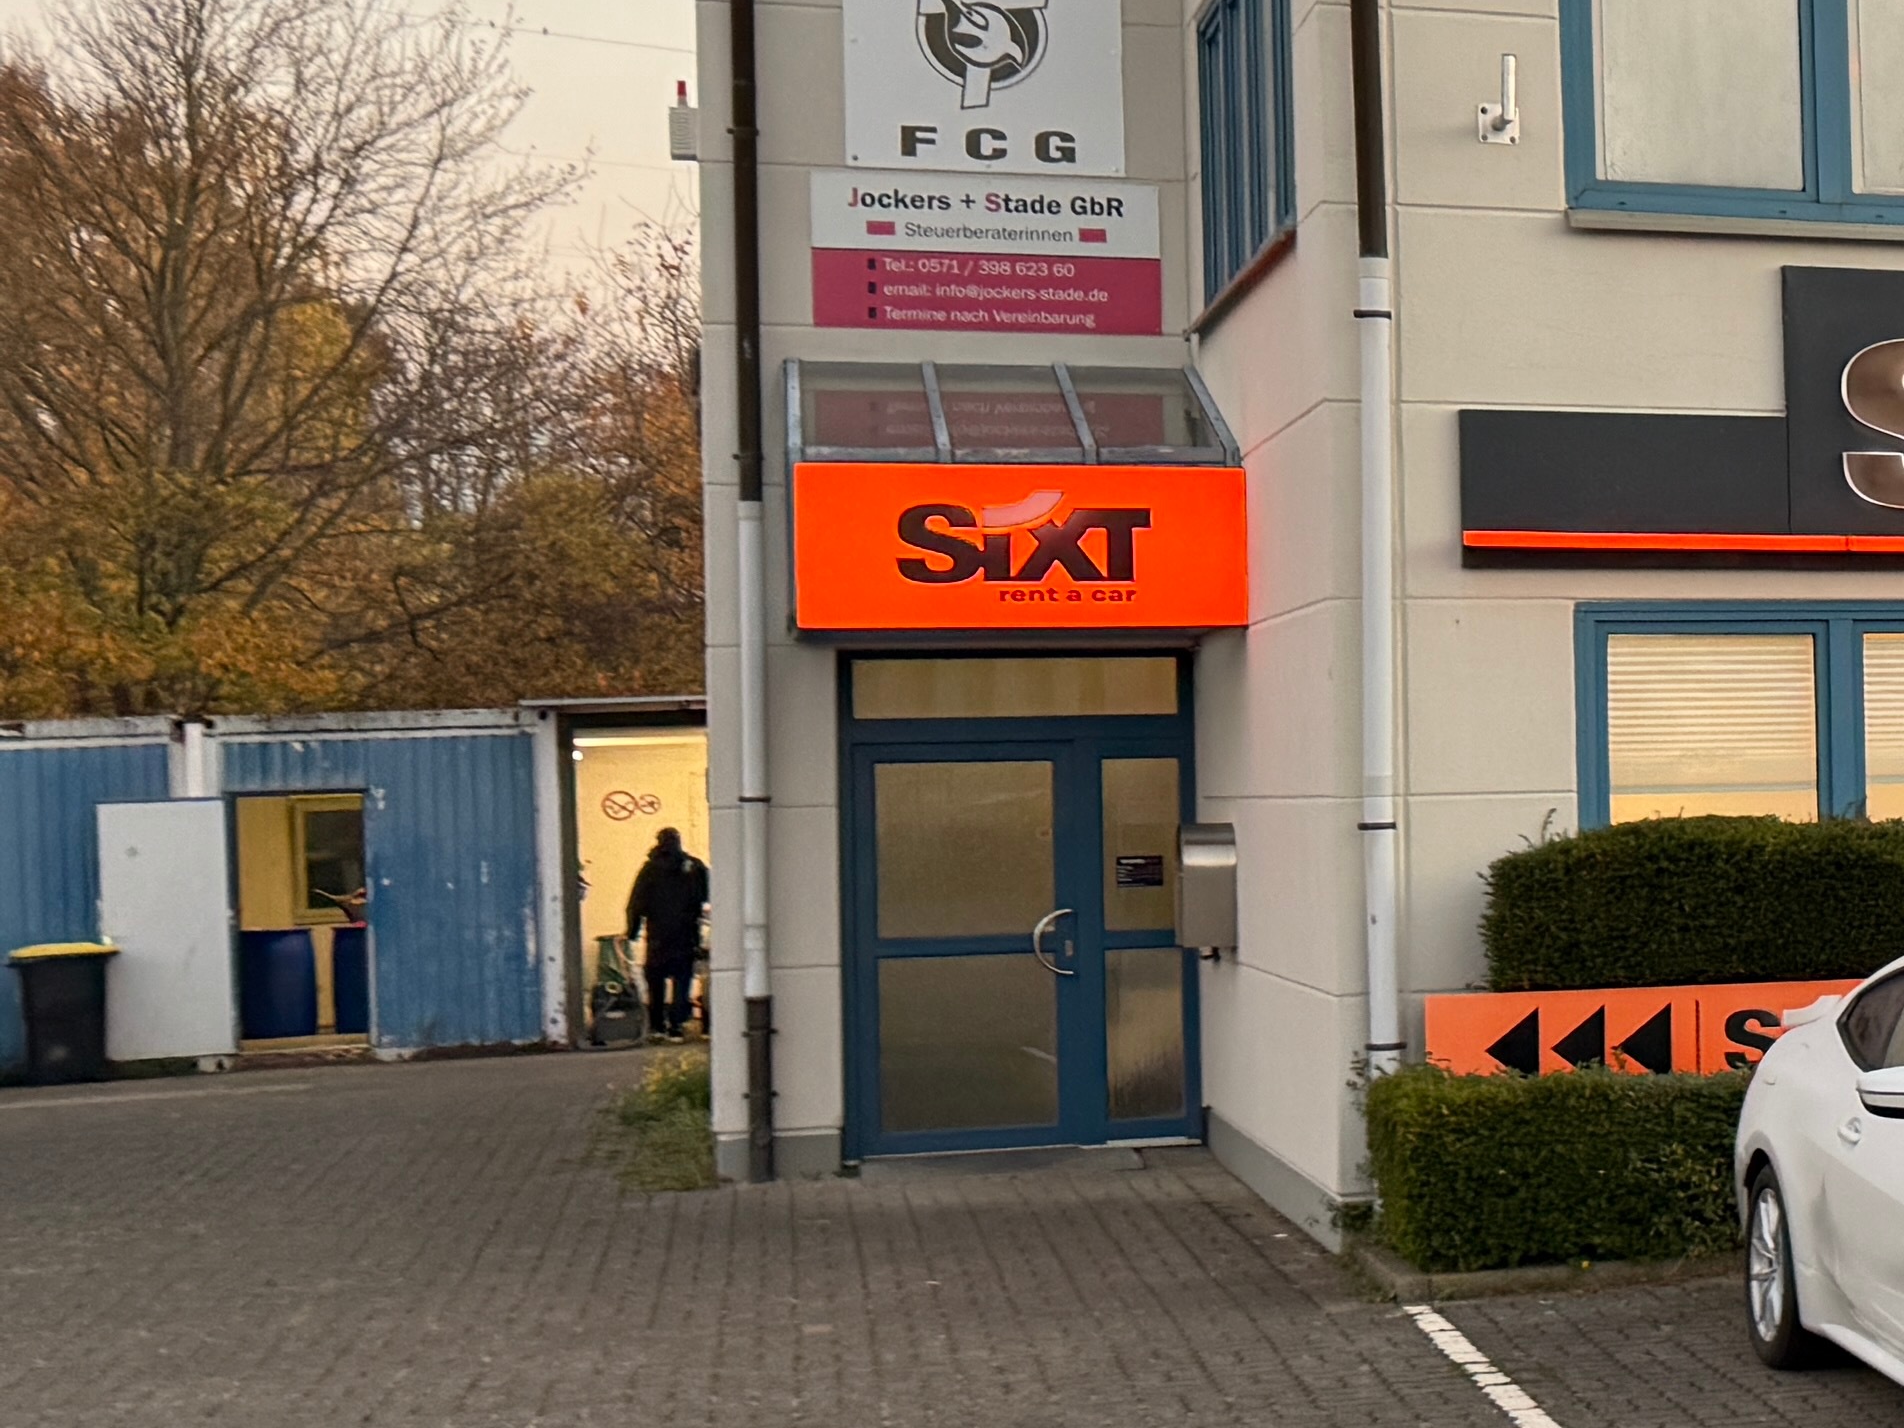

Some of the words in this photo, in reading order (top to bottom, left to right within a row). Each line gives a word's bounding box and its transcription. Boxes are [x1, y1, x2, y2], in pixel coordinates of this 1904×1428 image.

[848, 187, 951, 211] Jockers
[960, 193, 976, 209] +
[985, 192, 1061, 214] Stade
[1070, 195, 1123, 217] GbR
[905, 222, 1073, 243] Steuerberaterinnen
[918, 259, 960, 274] 0571
[1016, 262, 1048, 276] 623
[1053, 263, 1075, 277] 60
[936, 283, 1108, 302] info@jockers-stade.de
[884, 306, 947, 321] Termine
[950, 308, 989, 322] nach
[995, 309, 1096, 328] Vereinbarung
[1000, 588, 1059, 602] rent
[1066, 589, 1081, 601] a
[1092, 589, 1136, 602] car
